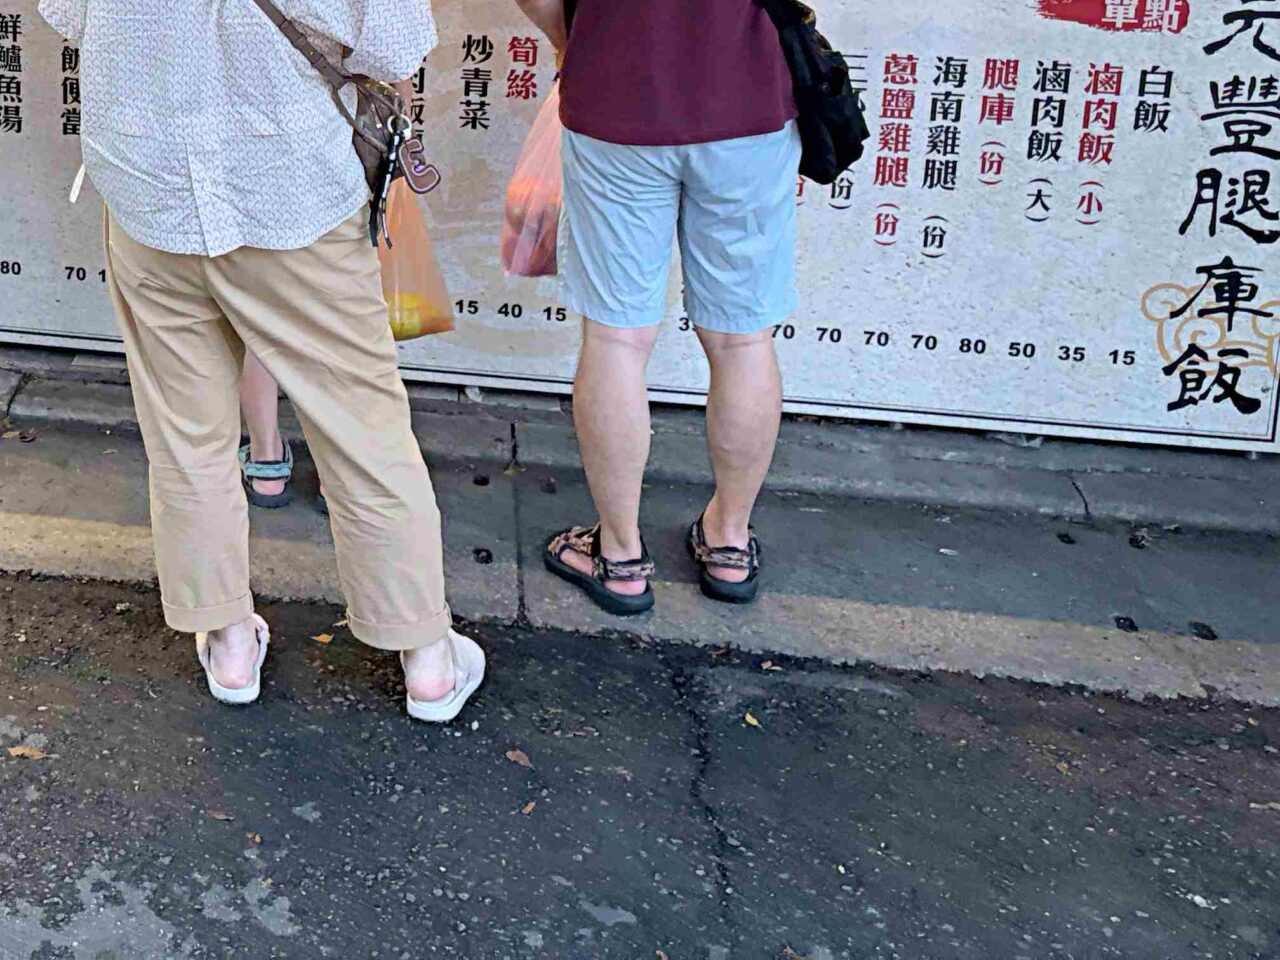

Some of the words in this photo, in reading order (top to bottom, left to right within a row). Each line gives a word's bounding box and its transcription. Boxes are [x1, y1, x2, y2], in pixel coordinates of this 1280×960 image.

[458, 34, 494, 131] 炒青菜
[505, 35, 538, 101] 筍絲
[1133, 65, 1174, 133] 白飯
[0, 260, 22, 276] 80
[64, 266, 87, 282] 70
[455, 299, 479, 315] 15
[497, 302, 523, 319] 40
[543, 306, 567, 322] 15
[816, 327, 842, 343] 70
[863, 330, 889, 347] 70
[911, 334, 938, 350] 70
[959, 338, 986, 354] 80
[1008, 342, 1036, 358] 50
[1058, 345, 1085, 362] 35
[1109, 349, 1135, 366] 15
